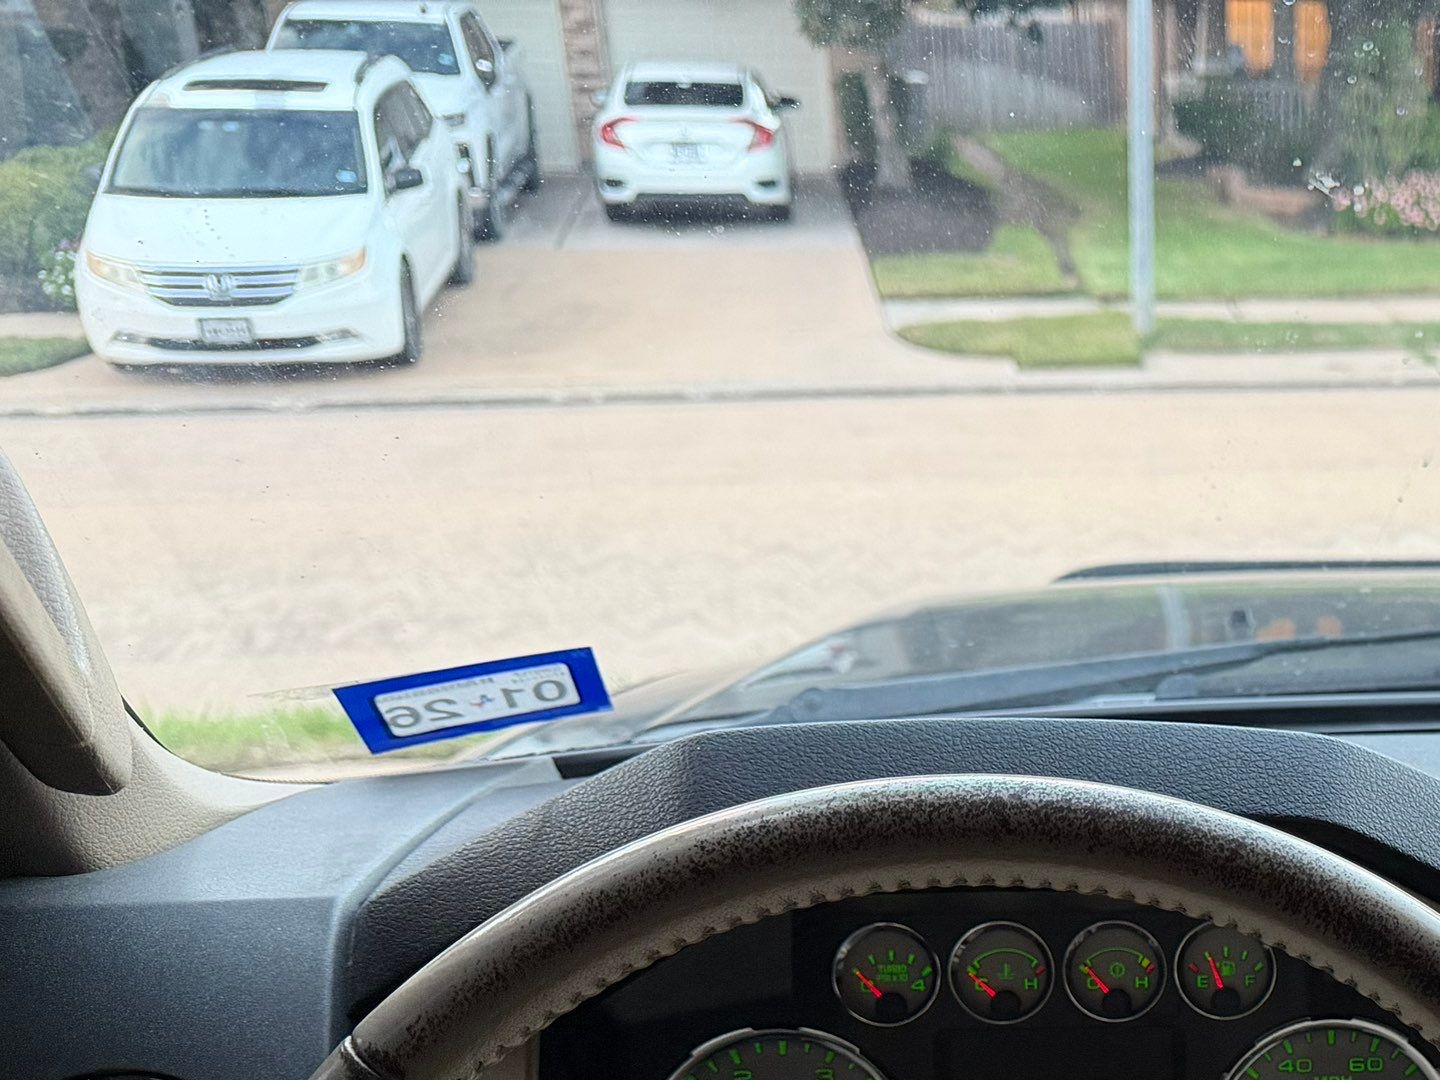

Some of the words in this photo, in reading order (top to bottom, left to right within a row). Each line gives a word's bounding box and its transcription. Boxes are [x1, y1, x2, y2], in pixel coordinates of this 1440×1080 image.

[911, 979, 927, 992] 4
[1024, 978, 1040, 991] H
[1135, 976, 1150, 989] H
[1197, 975, 1210, 988] E
[1244, 975, 1256, 988] F
[1278, 1058, 1313, 1073] 40
[1349, 1057, 1384, 1072] 60
